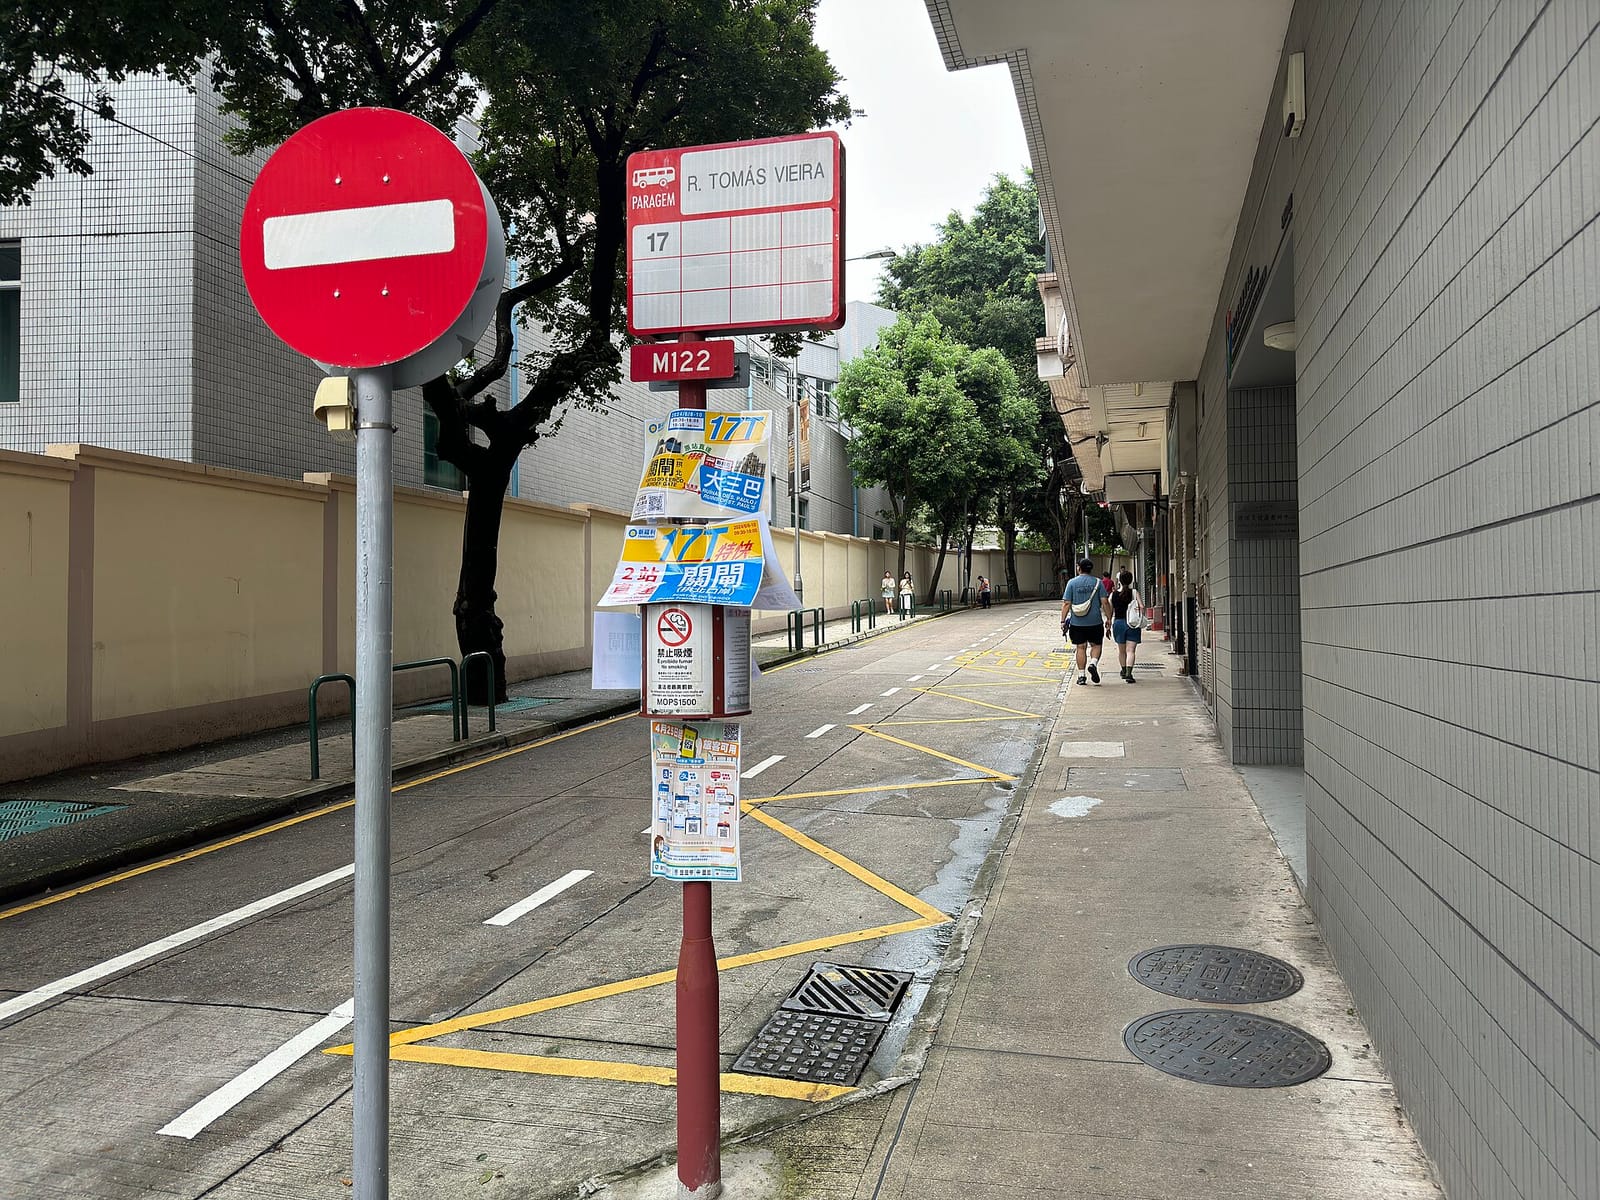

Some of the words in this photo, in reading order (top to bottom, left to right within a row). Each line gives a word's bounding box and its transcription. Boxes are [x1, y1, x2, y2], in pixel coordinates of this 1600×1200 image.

[687, 175, 702, 192] R.
[709, 164, 767, 190] TOMÁS
[774, 161, 825, 184] VIEIRA
[631, 192, 676, 210] PARAGEM
[646, 232, 670, 252] 17
[652, 349, 711, 374] M122
[709, 415, 765, 441] 17T
[703, 470, 762, 499] 大三巴
[659, 526, 729, 561] 17T
[678, 563, 745, 588] 關閘
[657, 647, 693, 658] 禁止吸煙
